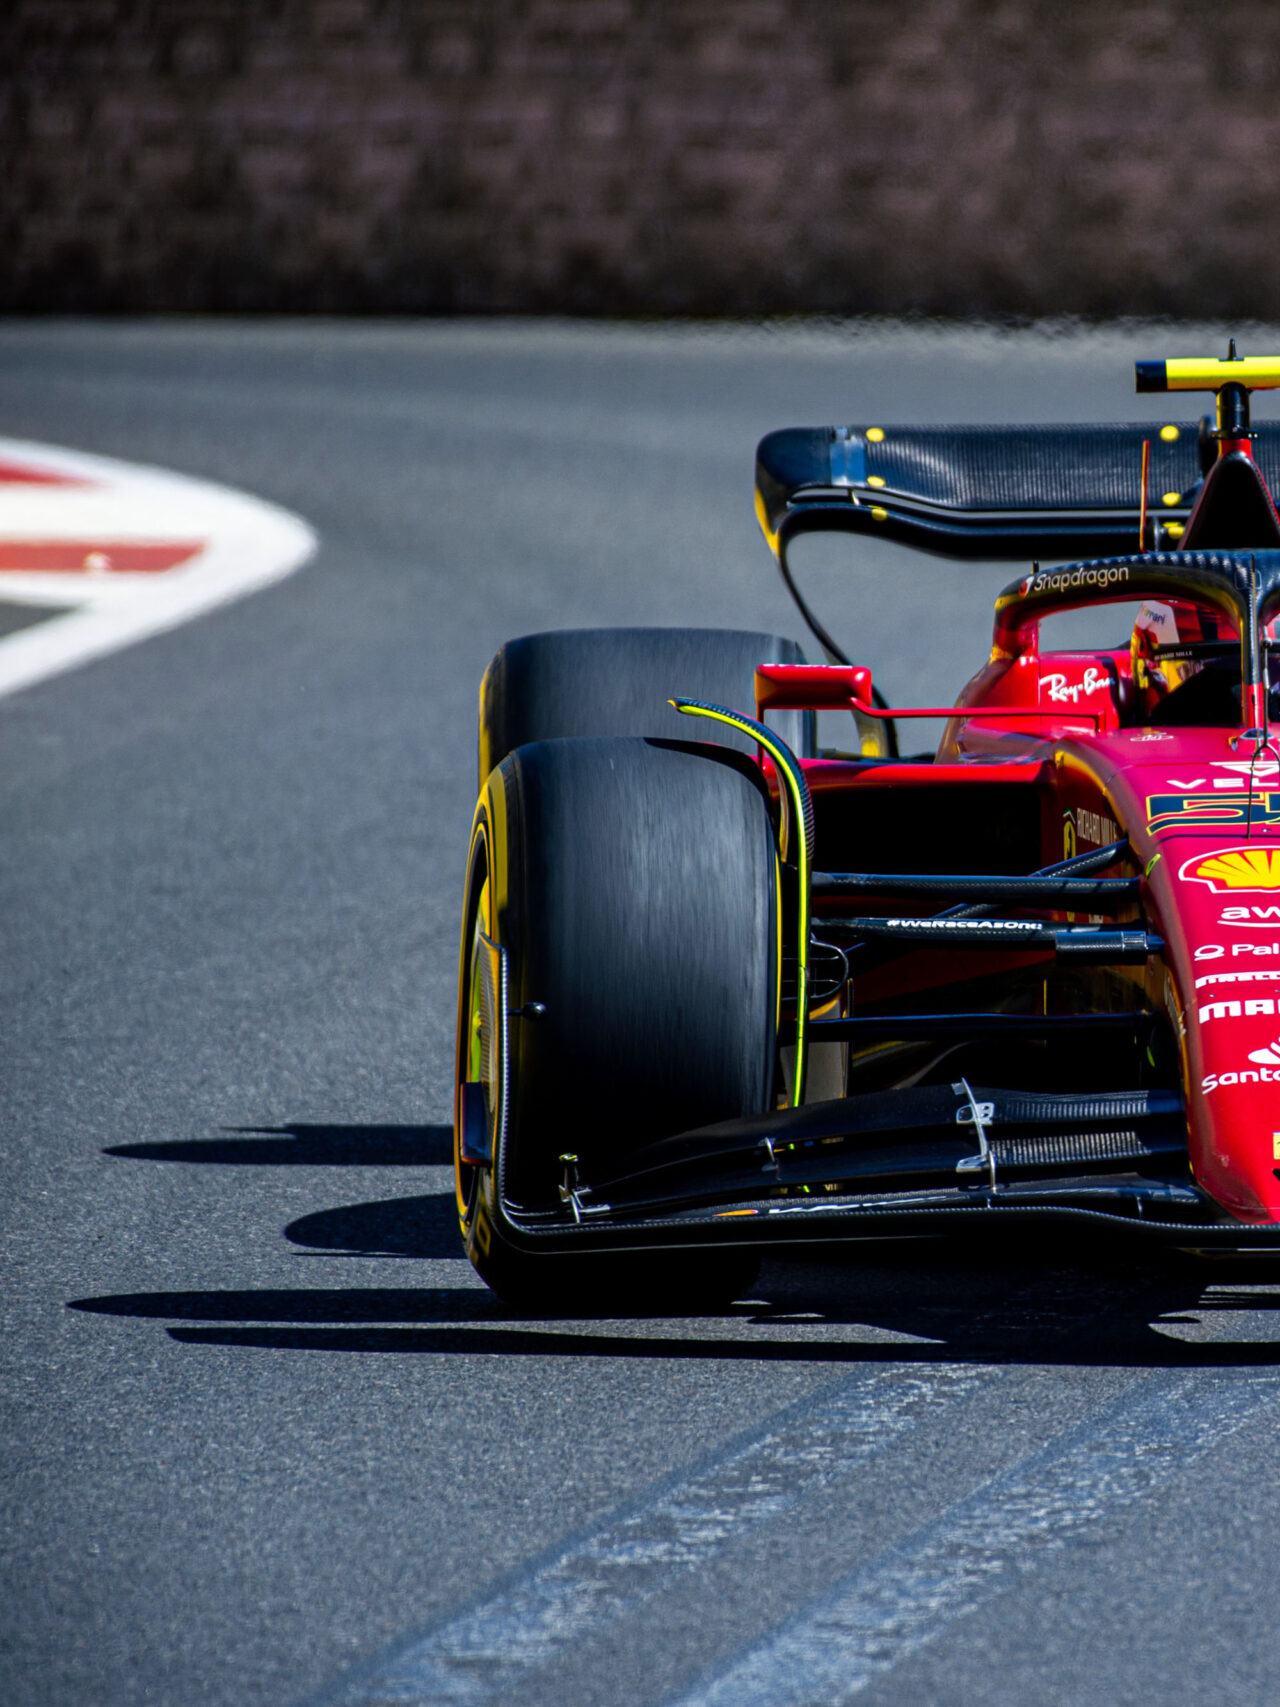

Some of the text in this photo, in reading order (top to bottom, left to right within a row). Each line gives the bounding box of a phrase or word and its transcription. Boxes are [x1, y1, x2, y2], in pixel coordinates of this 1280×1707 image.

[1034, 567, 1129, 592] Snapdragon
[1039, 668, 1116, 703] Ray-Ban
[886, 919, 1043, 930] #WeRaceAsOne
